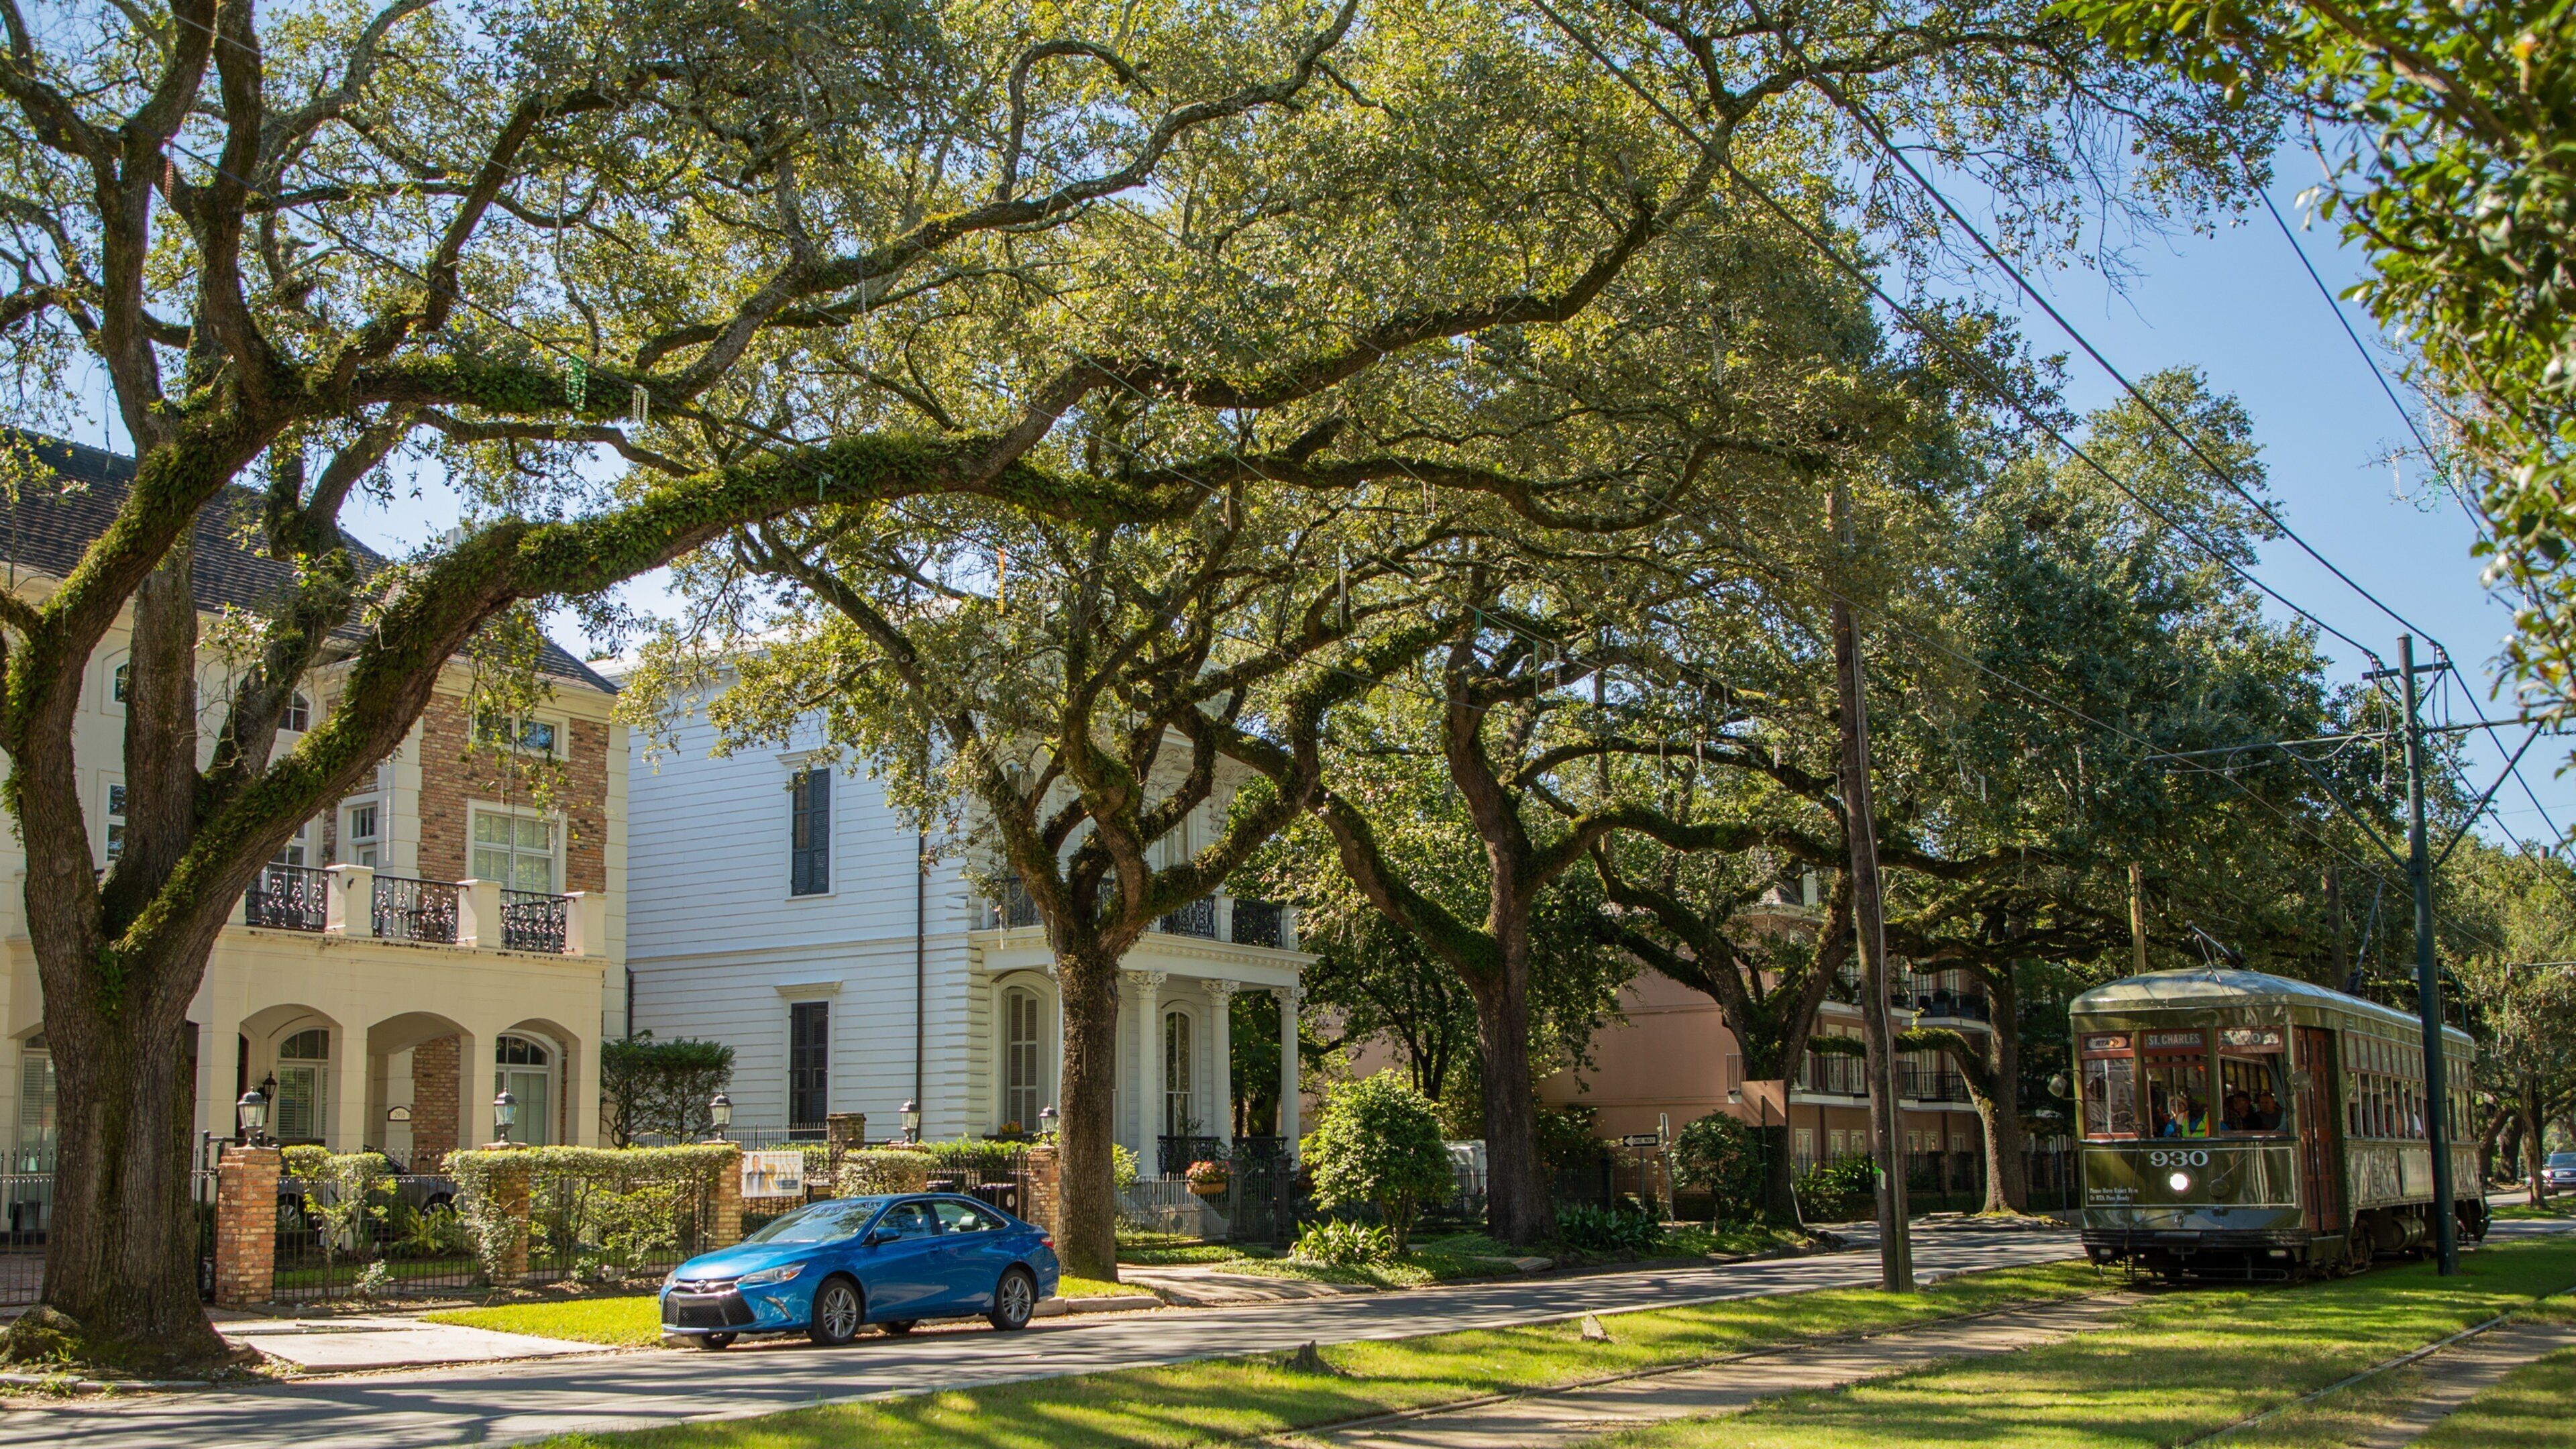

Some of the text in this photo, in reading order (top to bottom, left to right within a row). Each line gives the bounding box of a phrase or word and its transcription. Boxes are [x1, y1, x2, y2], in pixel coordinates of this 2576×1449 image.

[2148, 1033, 2200, 1045] ST. CHARLES
[2150, 1150, 2208, 1167] 930
[763, 1163, 798, 1191] RAY
